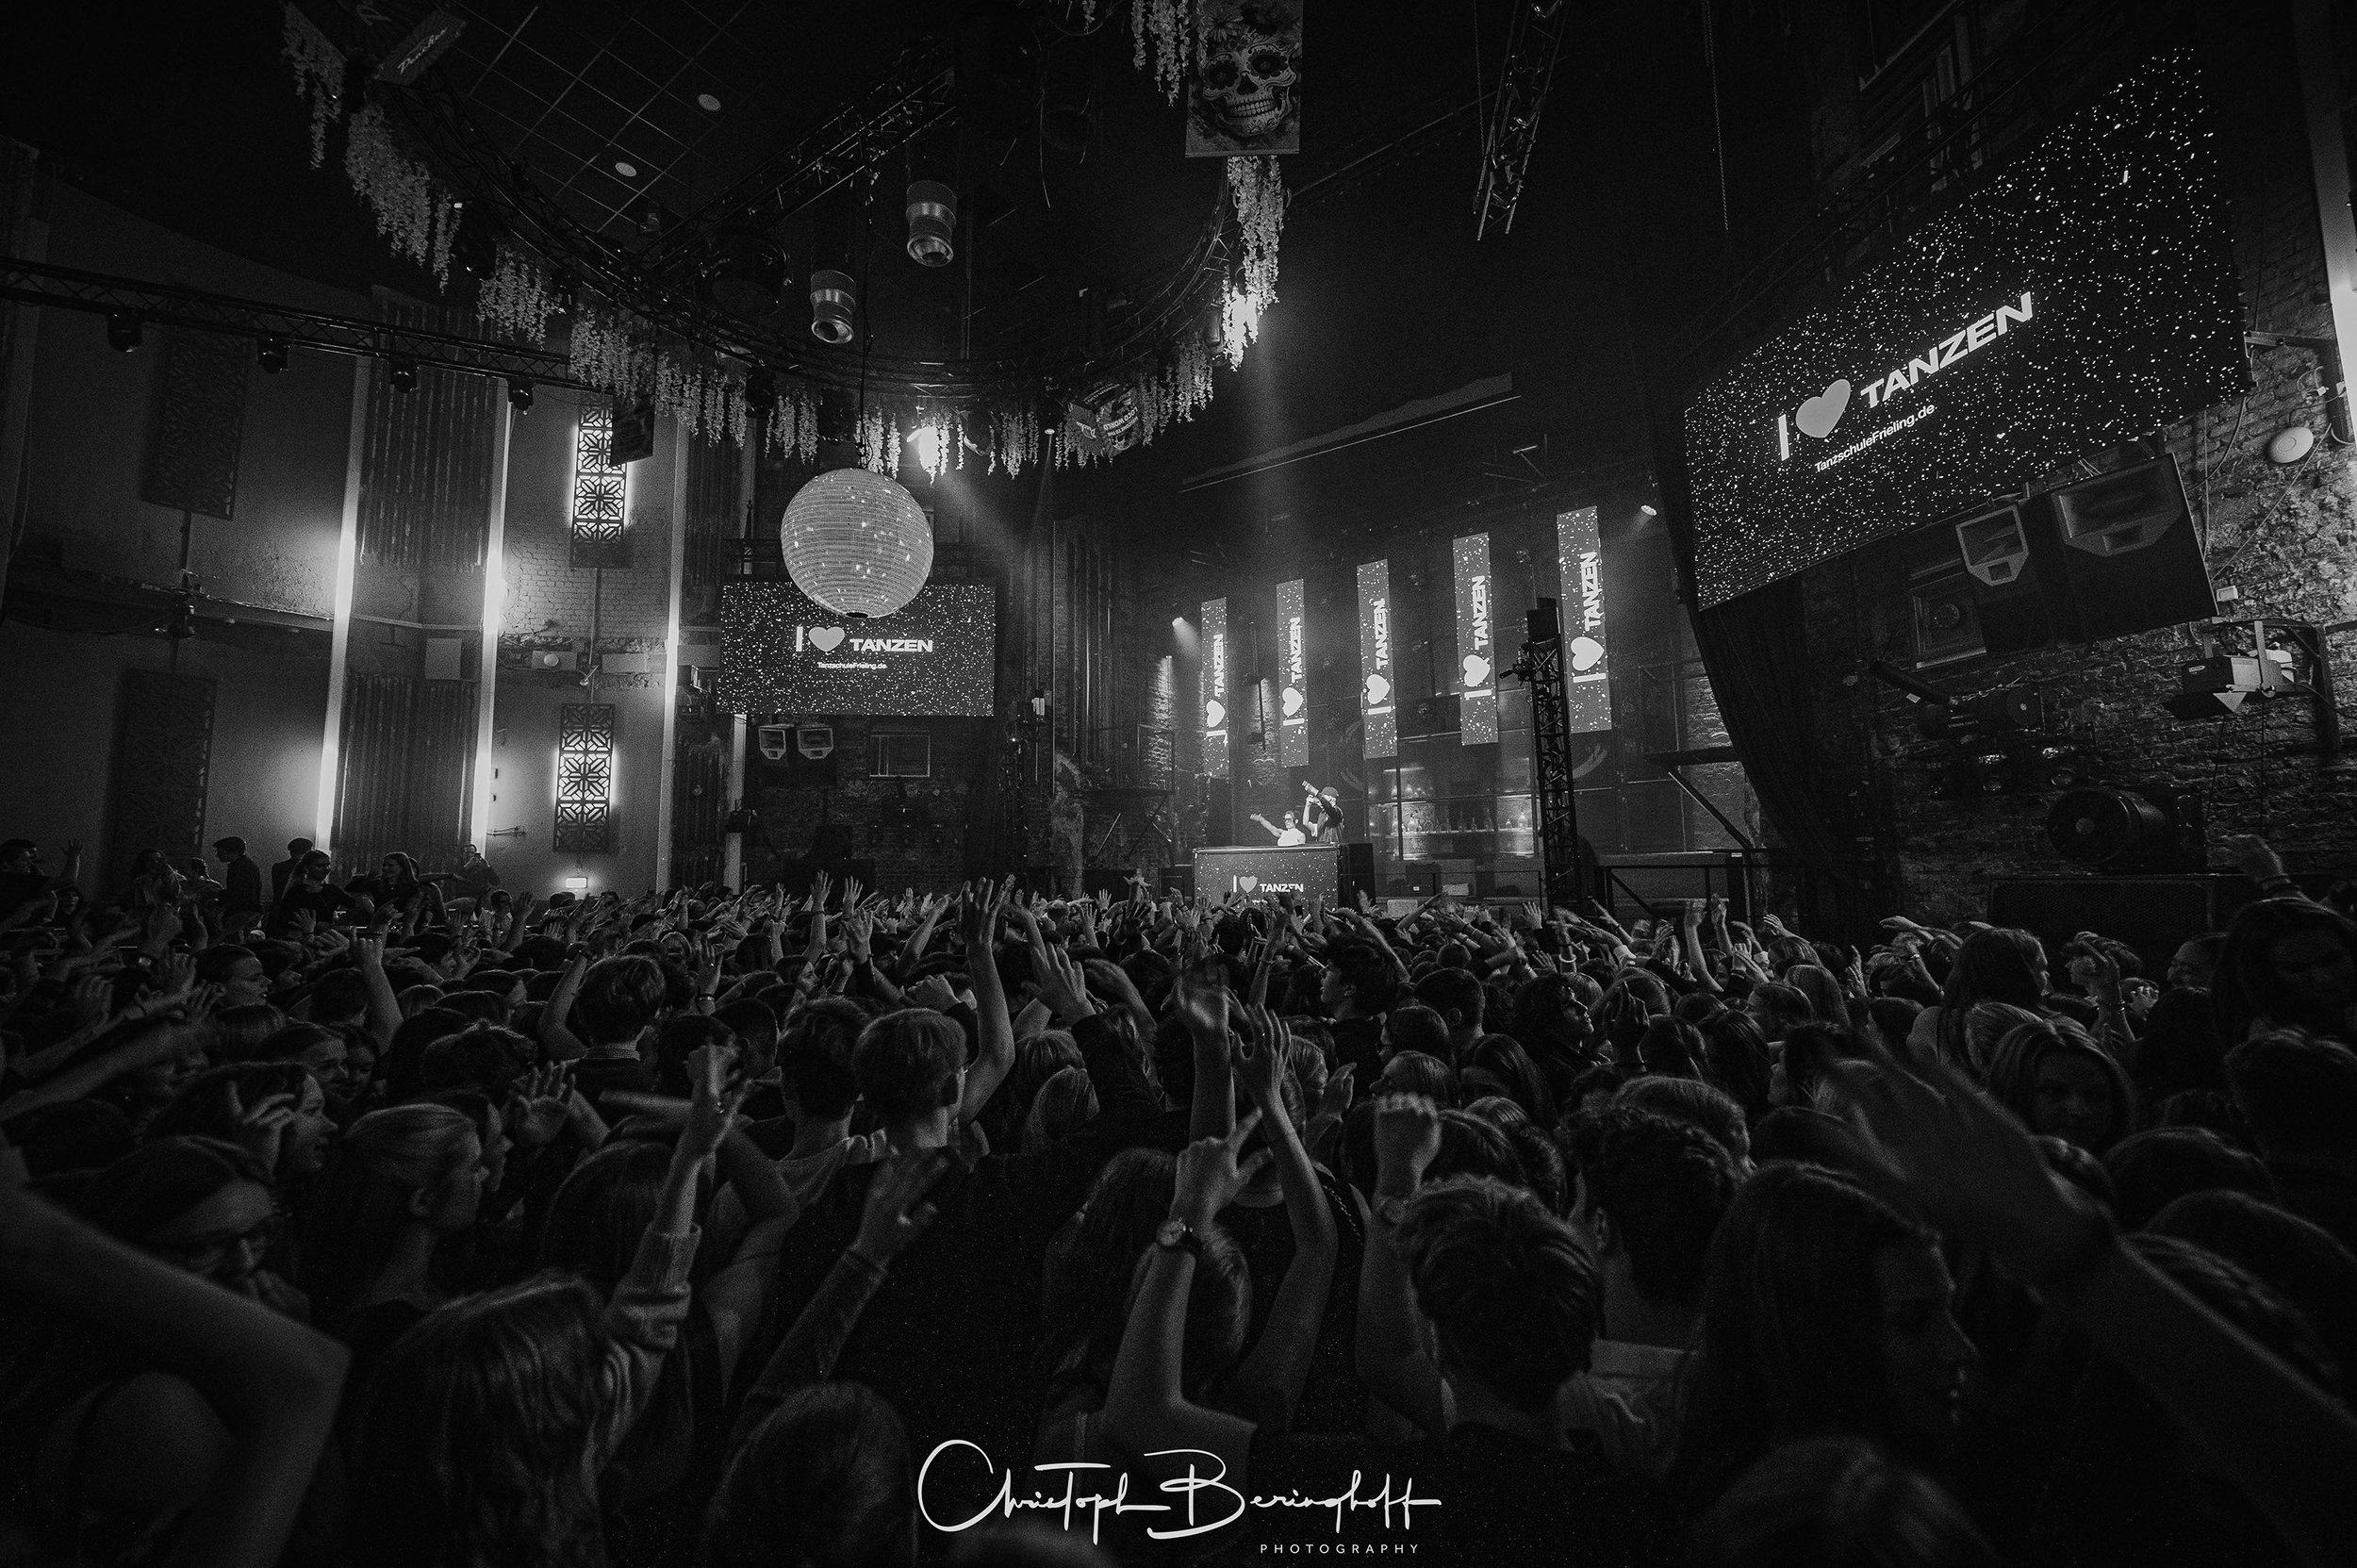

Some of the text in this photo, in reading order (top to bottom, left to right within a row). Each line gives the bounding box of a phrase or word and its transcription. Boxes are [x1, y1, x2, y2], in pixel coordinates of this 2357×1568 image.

[1777, 291, 2033, 462] I TANZEN
[1102, 418, 1124, 430] WORLD
[1814, 404, 1935, 472] TanzschuleFrieling.de
[796, 626, 933, 652] I TANZEN
[1290, 617, 1302, 683] TANZEN
[1374, 598, 1389, 669] TANZEN
[1464, 575, 1492, 699] I TANZEN
[1573, 552, 1607, 684] I TANZEN
[817, 662, 887, 670] TanzschuleFrieling.de
[1213, 634, 1225, 697] TANZEN
[1233, 875, 1237, 893] I
